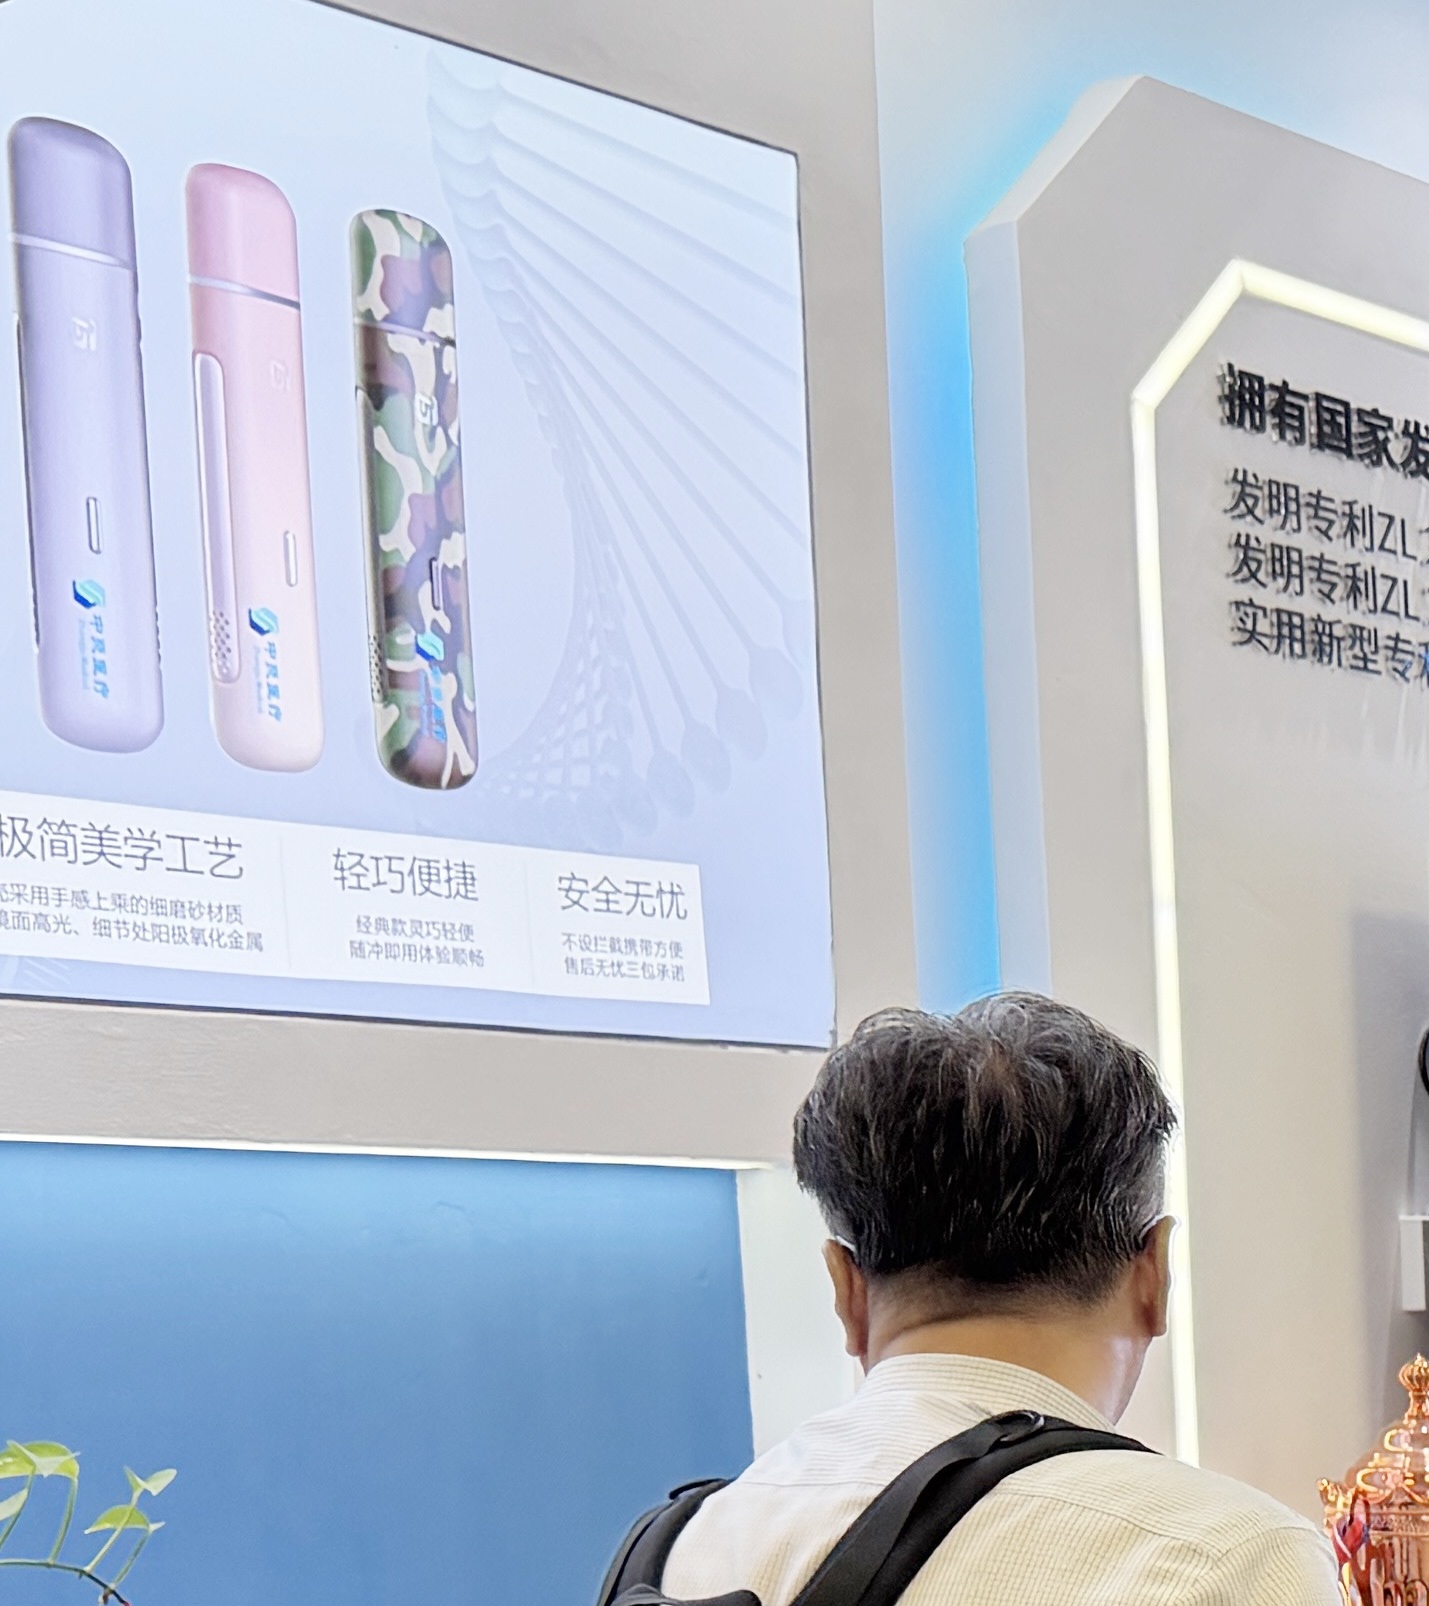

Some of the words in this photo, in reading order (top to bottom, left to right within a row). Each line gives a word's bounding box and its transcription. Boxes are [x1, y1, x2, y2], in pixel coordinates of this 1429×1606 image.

[0, 814, 244, 879] 极简美学工艺
[332, 848, 479, 901] 轻巧便捷
[557, 872, 688, 920] 安全无忧
